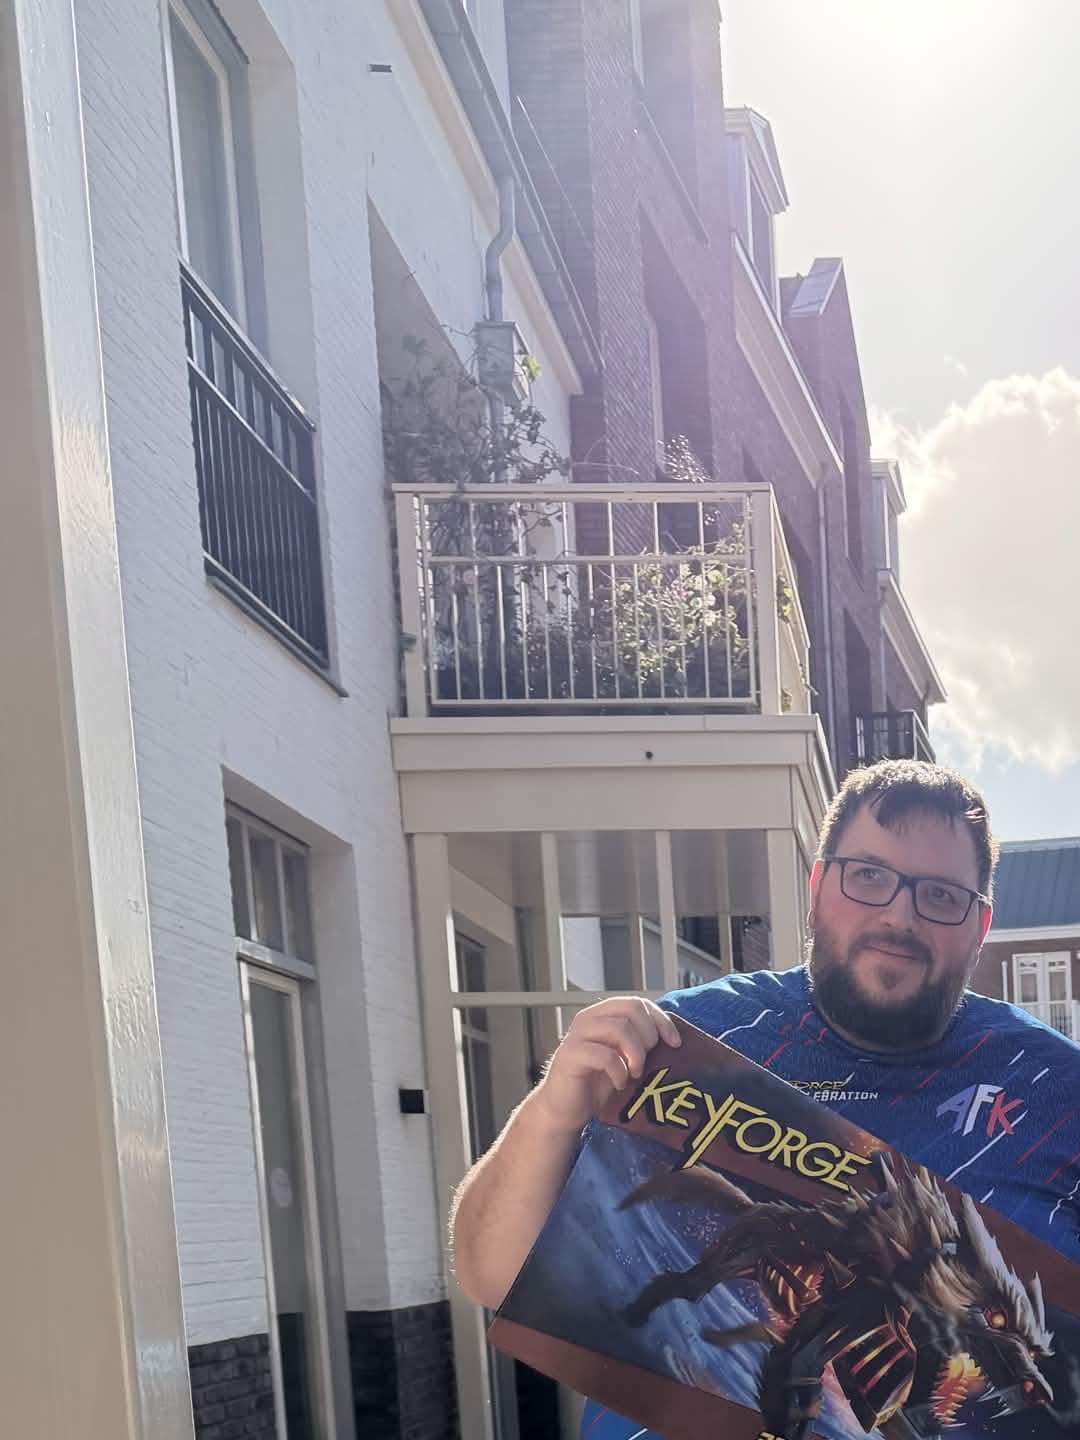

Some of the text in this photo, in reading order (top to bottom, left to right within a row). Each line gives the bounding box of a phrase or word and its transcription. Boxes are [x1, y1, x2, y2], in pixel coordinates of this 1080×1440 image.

[814, 1090, 879, 1102] EBRATION
[936, 1083, 1025, 1137] AFK
[627, 1067, 872, 1190] KEYFORGE
